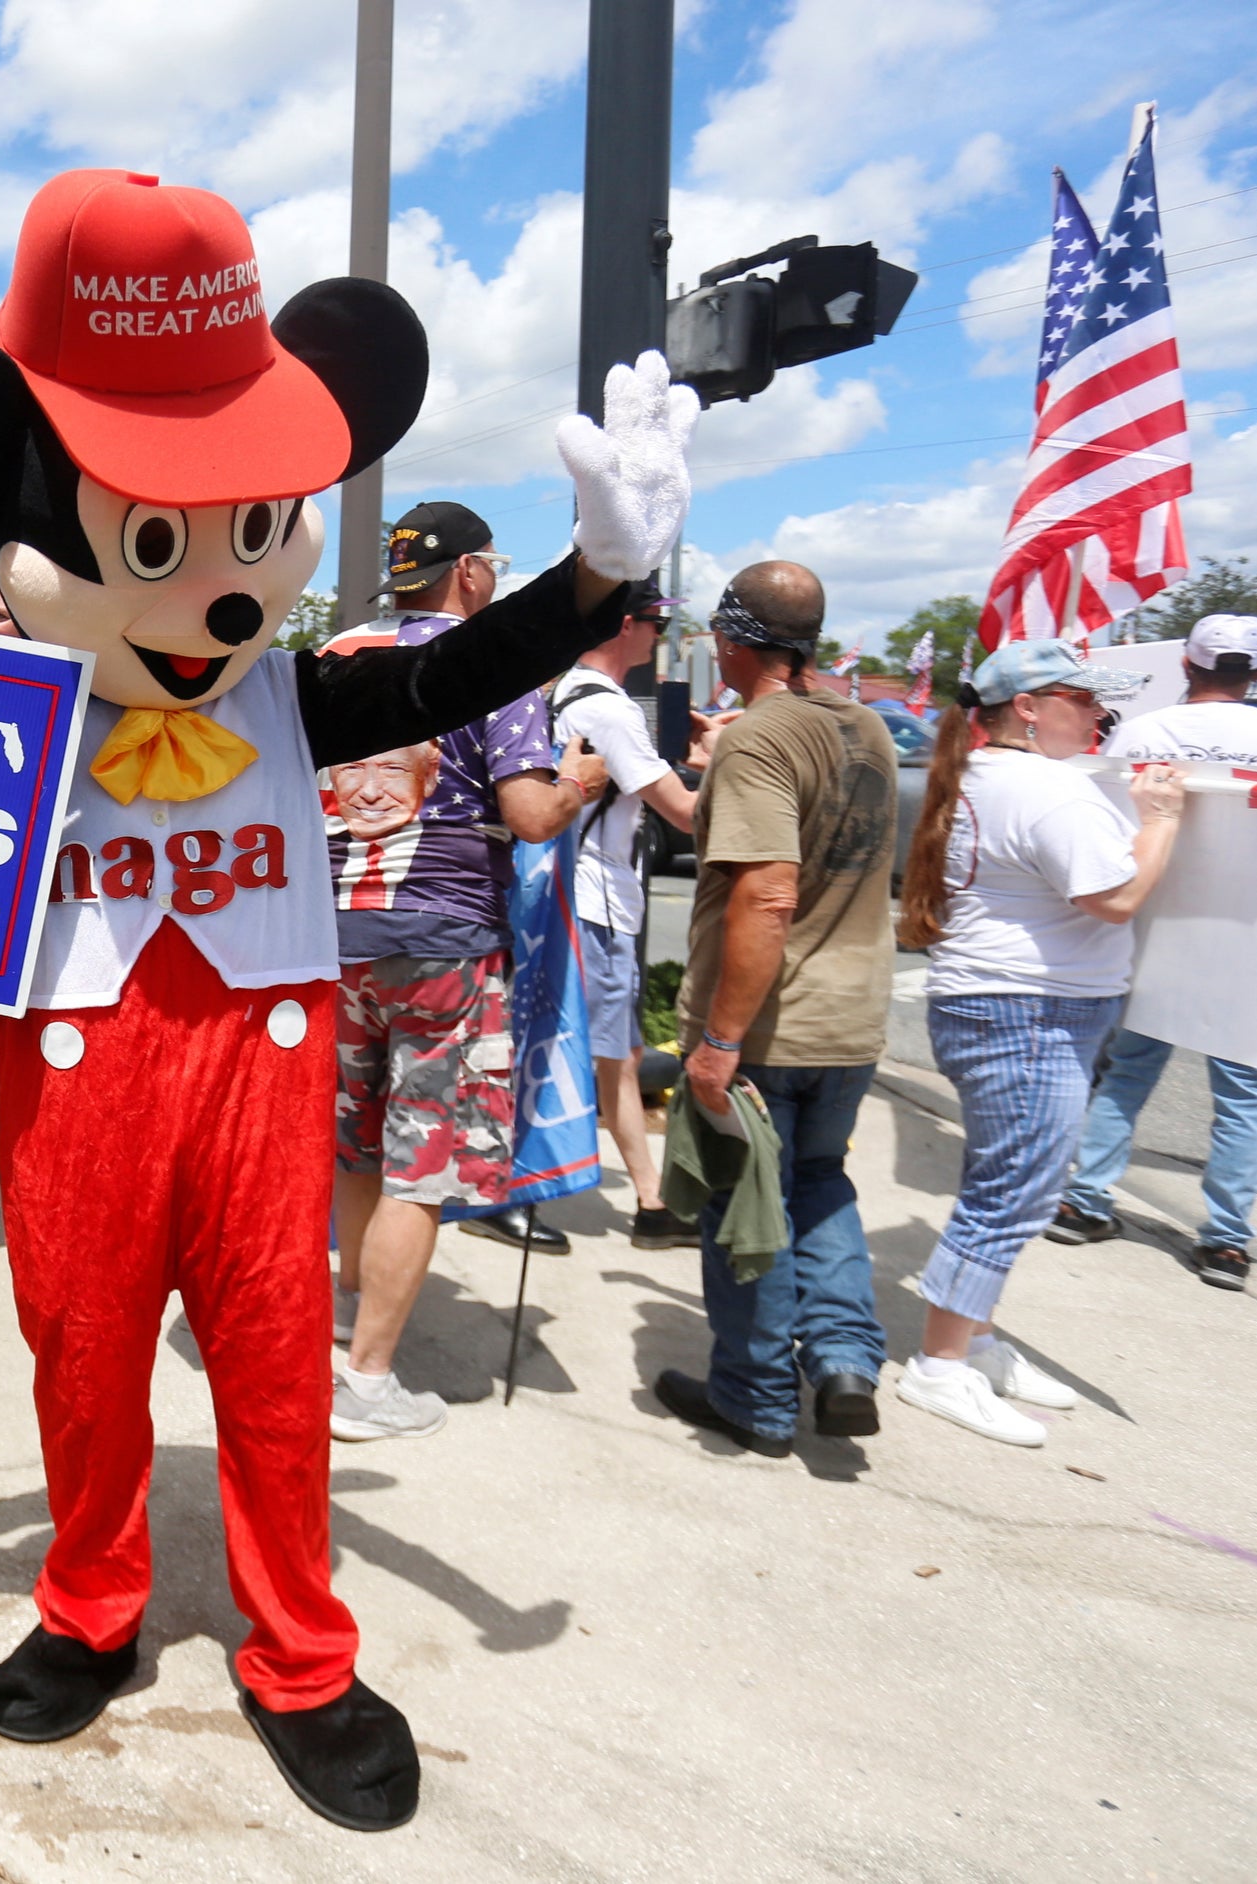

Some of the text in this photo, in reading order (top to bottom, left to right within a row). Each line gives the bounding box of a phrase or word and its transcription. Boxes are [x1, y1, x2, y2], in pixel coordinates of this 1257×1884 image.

[73, 258, 260, 302] MAKE AMERIC
[88, 309, 199, 336] GREAT
